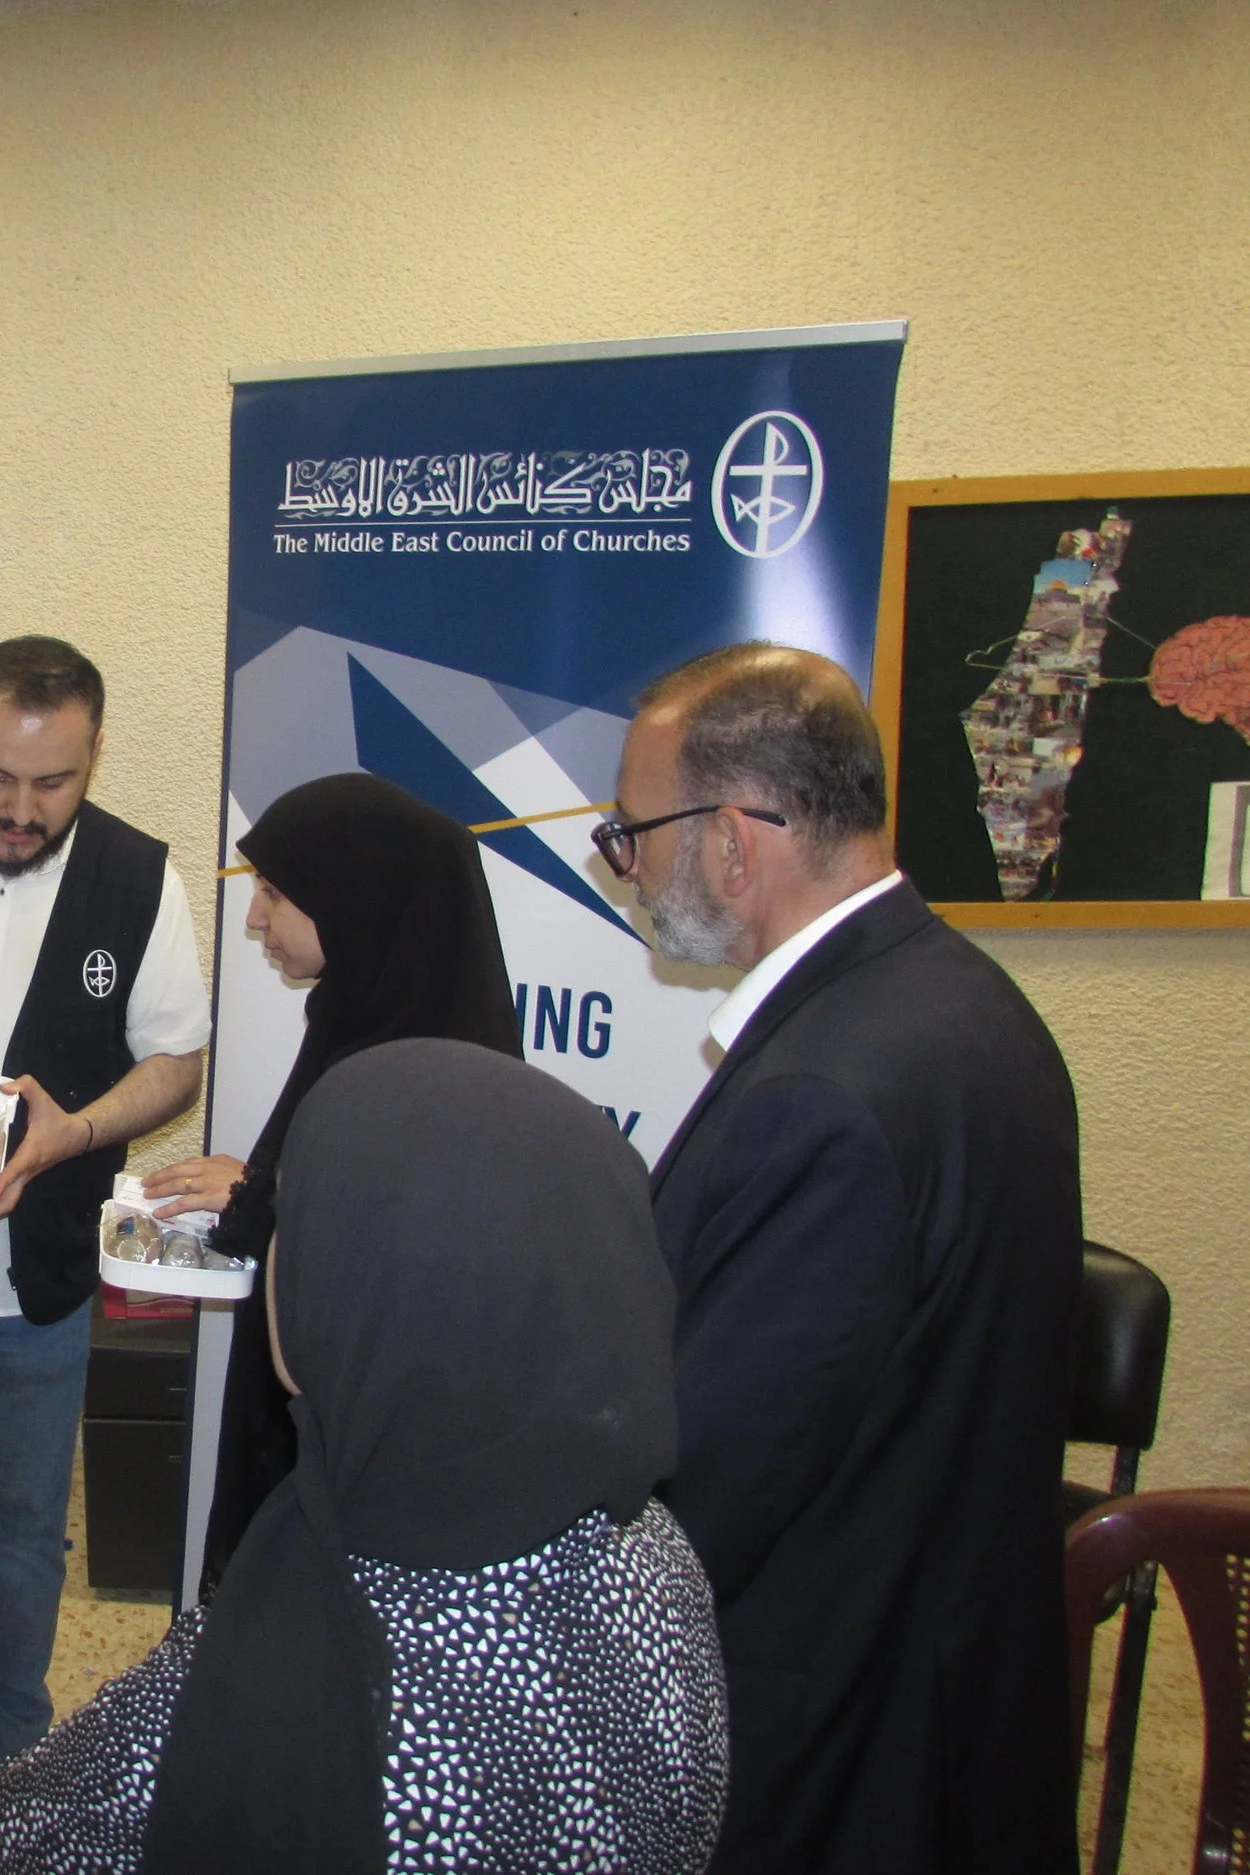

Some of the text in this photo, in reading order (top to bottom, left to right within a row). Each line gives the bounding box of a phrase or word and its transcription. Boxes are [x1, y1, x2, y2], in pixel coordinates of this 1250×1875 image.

[387, 453, 475, 516] الشرق
[477, 451, 592, 514] كنائس
[598, 448, 691, 513] مجلس
[273, 529, 691, 553] The Middle East Council of Churches
